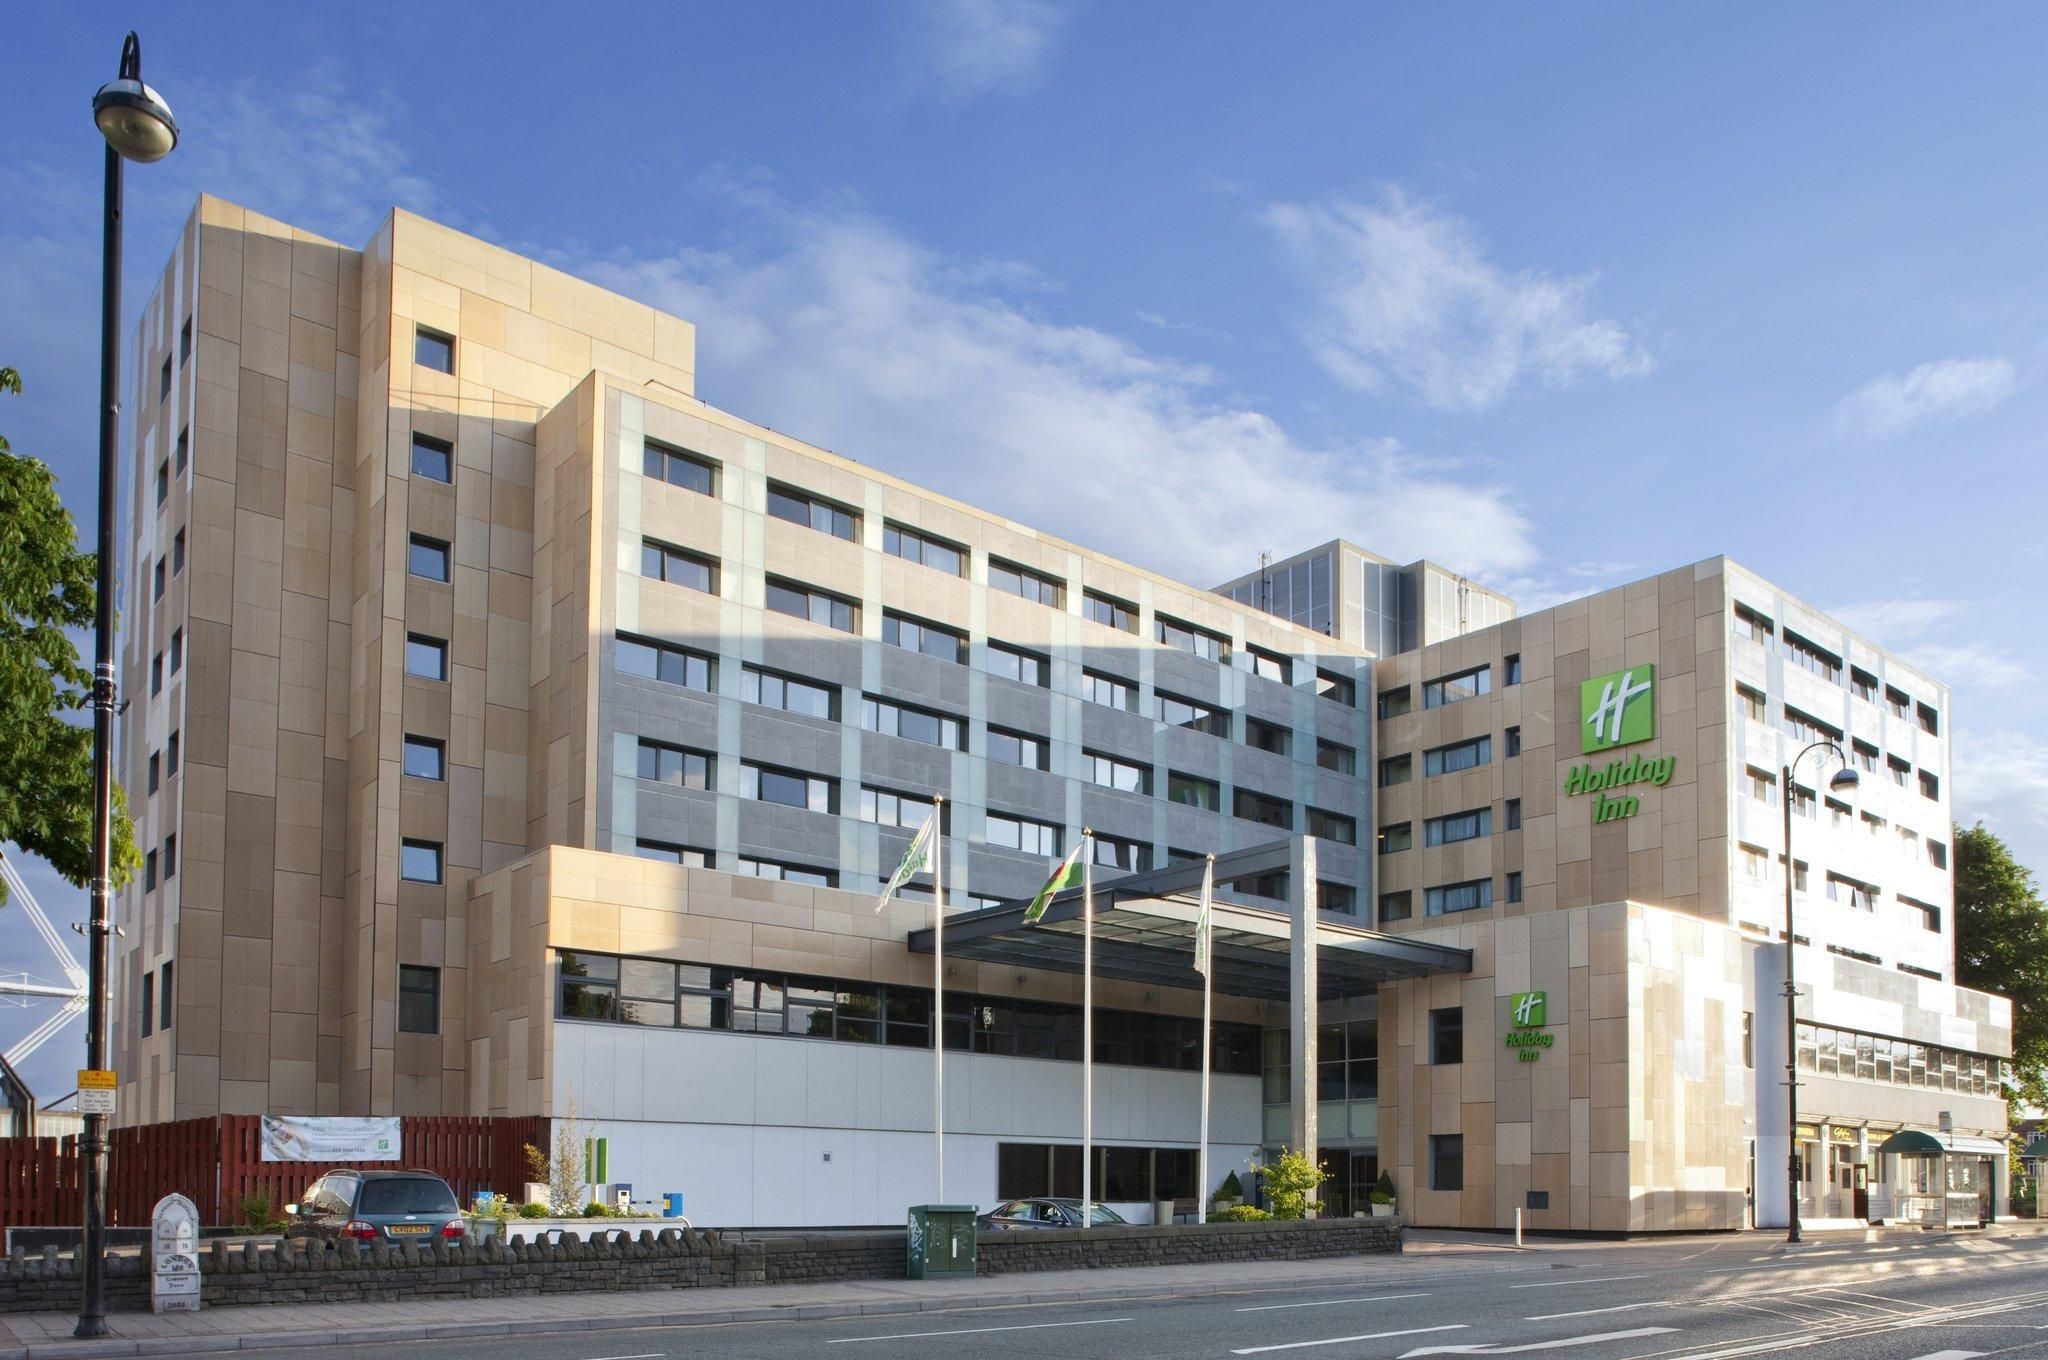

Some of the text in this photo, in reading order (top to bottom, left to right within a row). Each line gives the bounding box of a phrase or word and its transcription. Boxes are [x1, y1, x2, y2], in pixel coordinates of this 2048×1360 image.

[1564, 753, 1676, 797] Holiday
[1593, 793, 1639, 824] Inn
[1505, 1032, 1554, 1049] Holiday
[1519, 1049, 1540, 1062] Inn
[161, 1255, 193, 1269] LONDON
